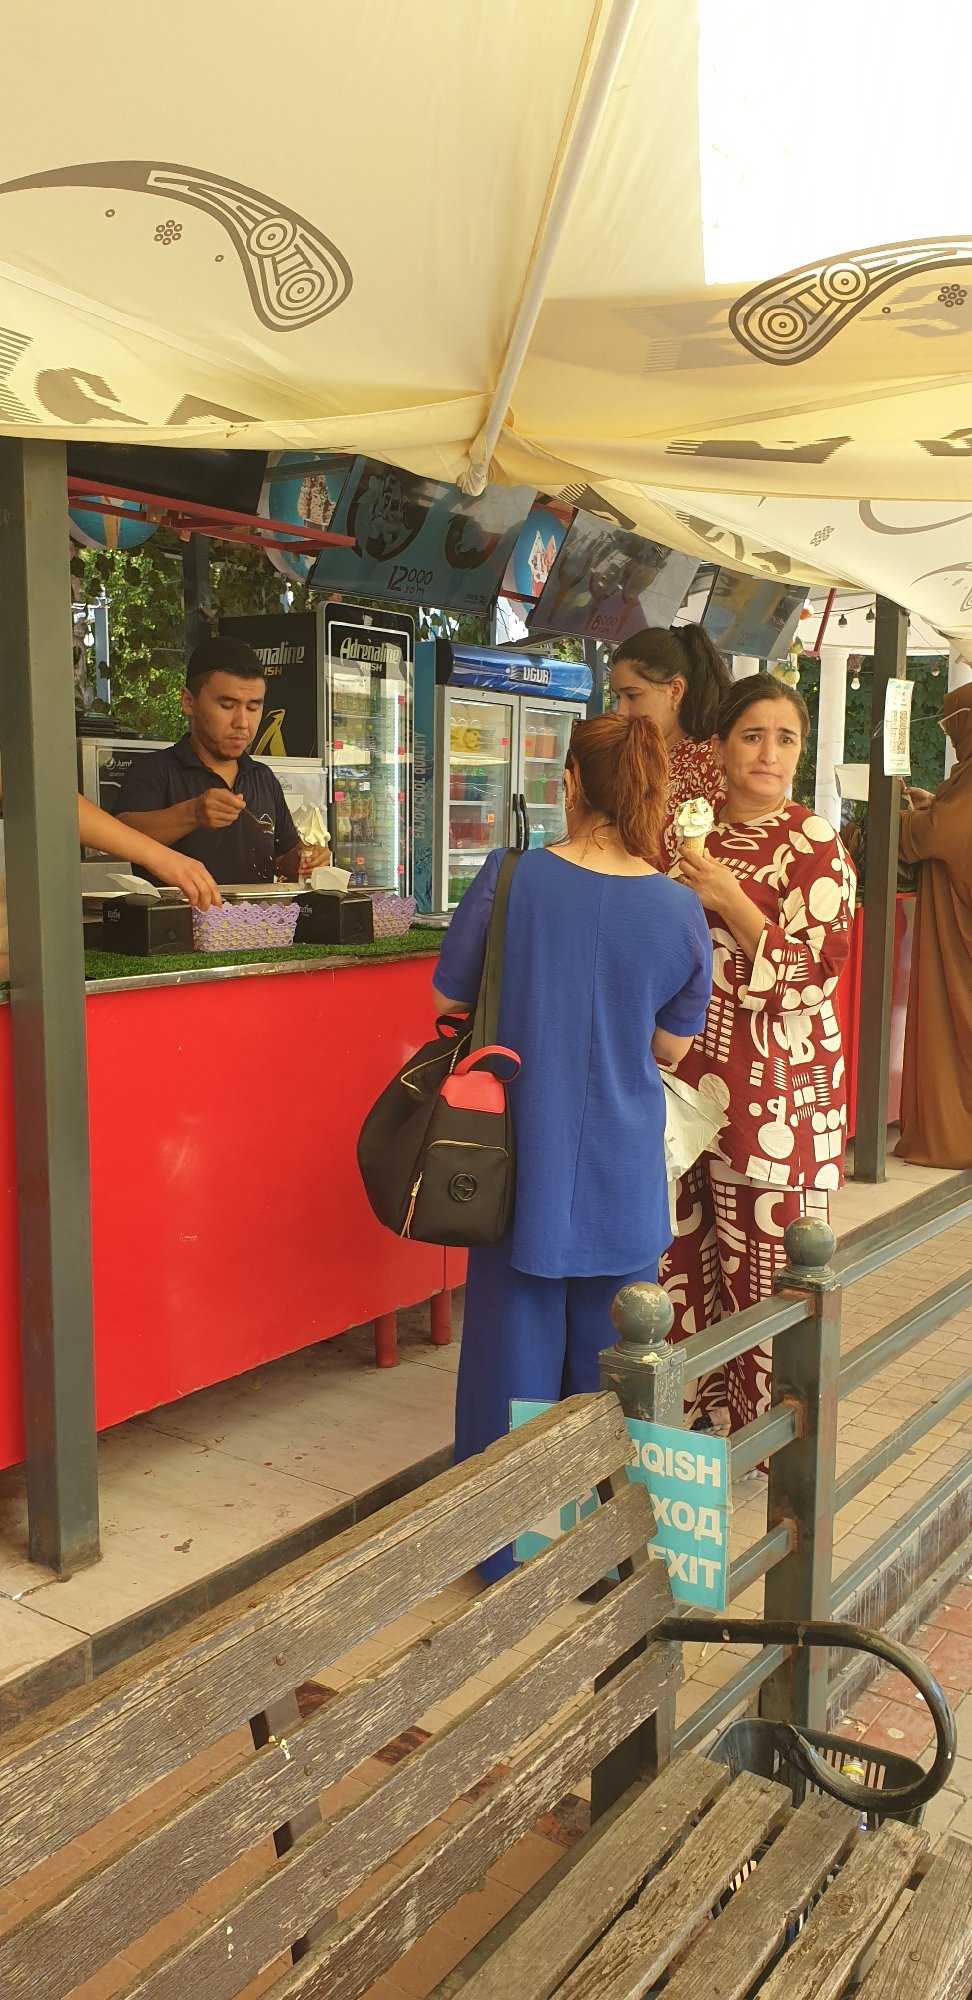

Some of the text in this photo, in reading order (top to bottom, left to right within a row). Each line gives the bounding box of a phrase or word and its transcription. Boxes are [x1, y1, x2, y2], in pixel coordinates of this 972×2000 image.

[340, 637, 400, 667] Adrenaline
[360, 662, 382, 672] RUSH
[414, 732, 427, 839] ENJOY COOL QUALITY
[625, 1439, 720, 1488] IQISH
[650, 1494, 722, 1545] ХОД
[647, 1543, 721, 1589] EXIT
